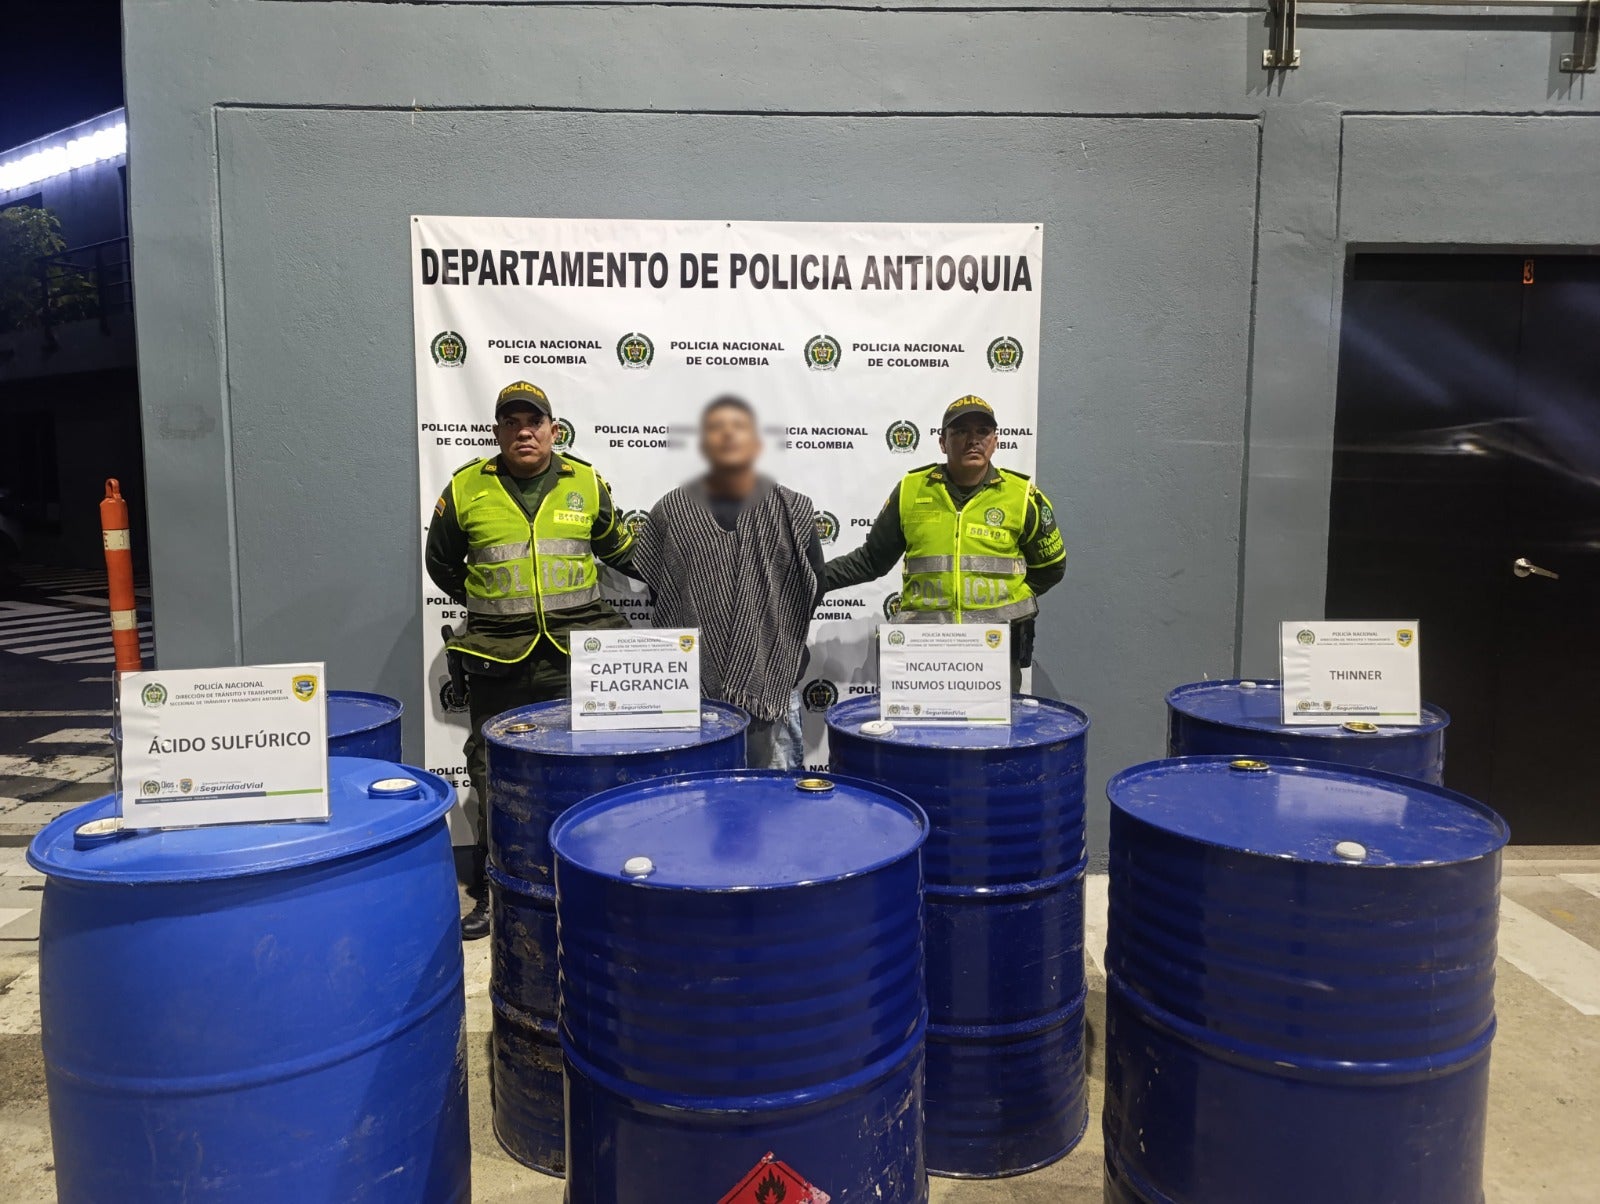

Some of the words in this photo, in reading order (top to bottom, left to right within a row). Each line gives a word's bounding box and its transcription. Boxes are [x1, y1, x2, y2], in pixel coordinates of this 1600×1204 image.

[421, 248, 669, 289] DEPARTAMENTO
[680, 252, 719, 289] DE
[730, 253, 852, 290] POLICIA
[861, 255, 1032, 294] ANTIOQUIA
[488, 340, 537, 349] POLICIA
[540, 340, 602, 350] NACIONAL
[670, 341, 720, 350] POLICIA
[723, 342, 785, 351] NACIONAL
[852, 343, 900, 353] POLICIA
[904, 343, 965, 353] NACIONAL
[504, 355, 521, 364] DE
[523, 355, 587, 365] COLOMBIA
[686, 356, 703, 366] DE
[705, 356, 769, 366] COLOMBIA
[868, 358, 884, 367] DE
[887, 358, 949, 368] COLOMBIA
[421, 423, 467, 432] POLICIA
[594, 425, 640, 434] POLICIA
[811, 427, 868, 436] NACIONAL
[436, 437, 451, 446] DE
[455, 438, 500, 447] COLOMB
[609, 439, 624, 448] DE
[795, 440, 854, 450] COLOMBIA
[817, 599, 866, 607] ACIONAL
[442, 611, 456, 619] DE
[591, 662, 664, 675] CAPTURA
[668, 661, 688, 673] EN
[905, 662, 984, 672] INCAUTACION
[1329, 670, 1382, 680] THINNER
[194, 682, 223, 691] POLICÍA
[225, 681, 264, 690] NACIONAL
[590, 678, 689, 692] FLAGRANCIA
[891, 681, 944, 690] INSUMOS
[948, 681, 1002, 691] LIQUIDOS
[148, 735, 205, 754] ÁCIDO
[211, 730, 311, 751] SULFÚRICO
[429, 767, 467, 776] POLICI
